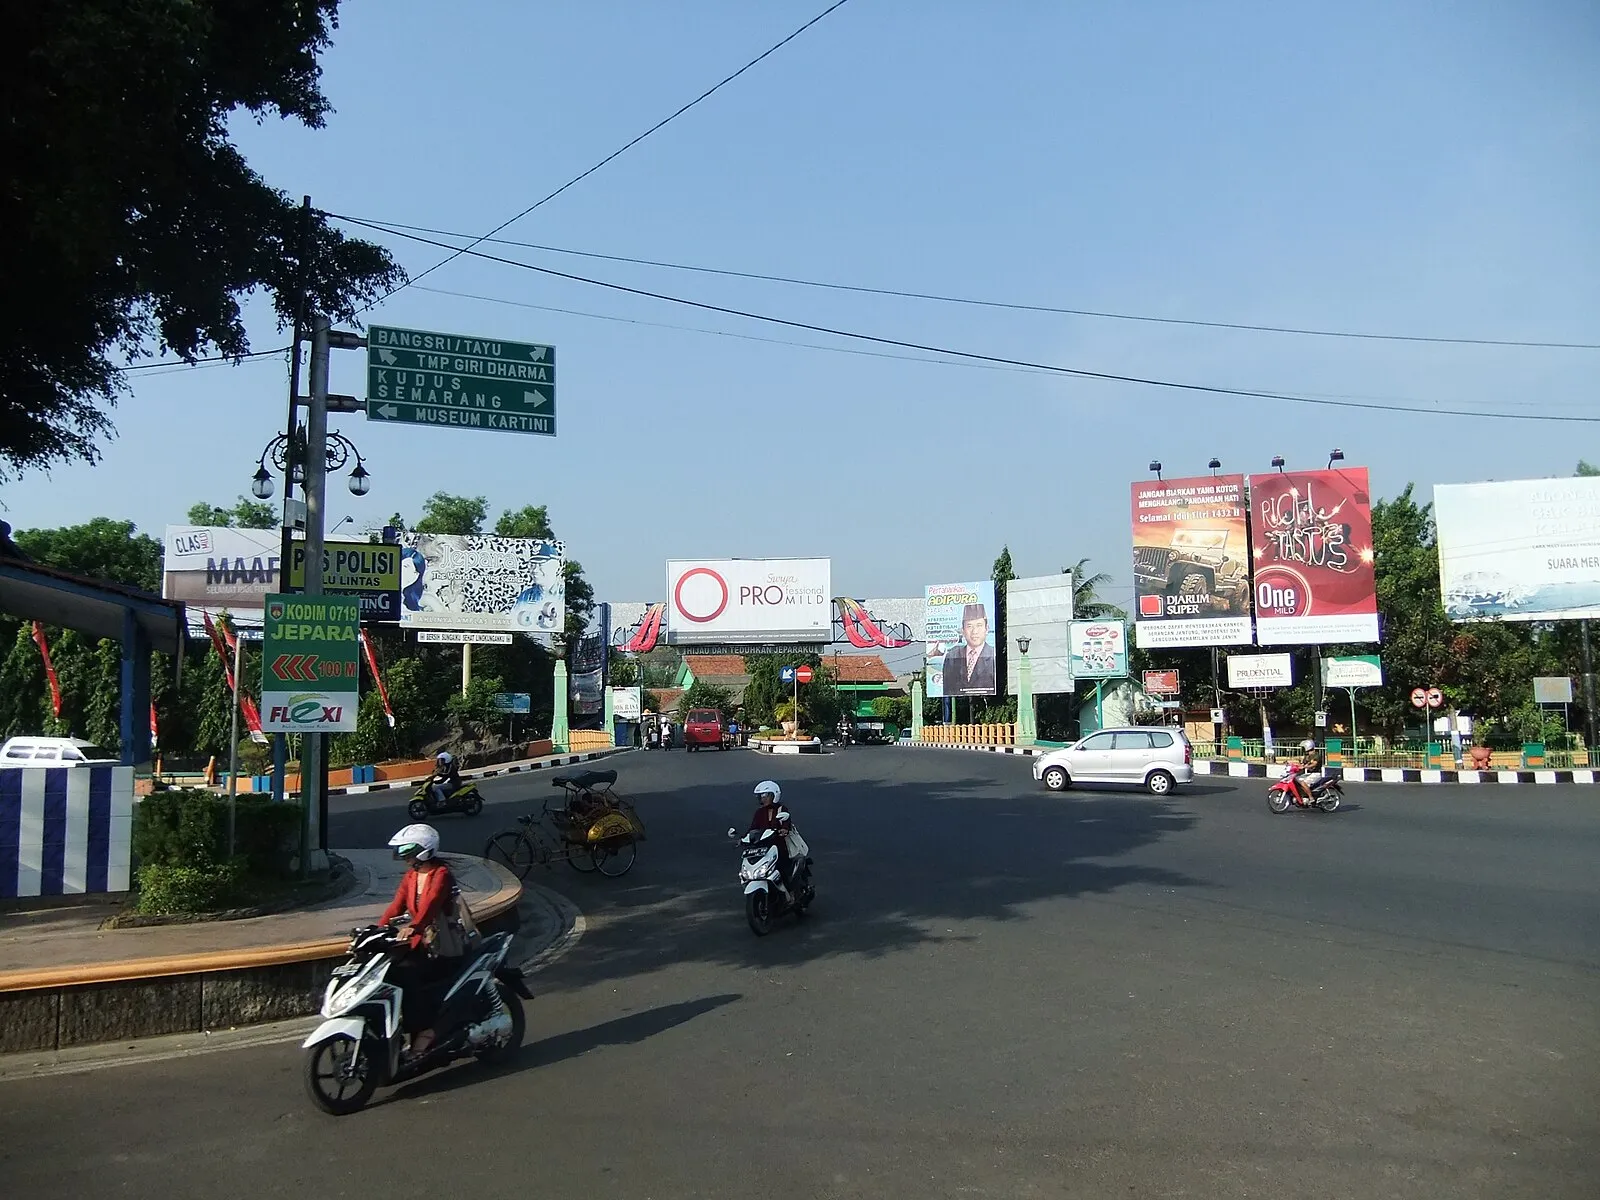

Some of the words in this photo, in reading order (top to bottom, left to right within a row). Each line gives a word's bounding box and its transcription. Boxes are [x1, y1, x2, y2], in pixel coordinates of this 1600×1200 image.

[454, 358, 484, 374] GIRI
[487, 361, 547, 380] DHARMA
[378, 370, 461, 390] KUDUS
[378, 385, 502, 408] SEMARANG
[416, 408, 481, 426] MUSEUM
[488, 414, 548, 432] KARTINI
[1138, 490, 1164, 499] JANGAN
[1196, 486, 1215, 495] YANG
[1216, 484, 1238, 493] KOTOR
[1184, 496, 1223, 505] PANDANGAN
[1224, 494, 1239, 502] HATI
[1139, 513, 1170, 522] Selamat
[1212, 509, 1231, 518] 1432
[1233, 508, 1240, 516] H
[294, 549, 330, 572] PS
[336, 550, 394, 575] POLISI
[440, 545, 518, 570] Jepara
[1547, 558, 1578, 570] SUARA
[207, 557, 280, 584] MAAF
[432, 571, 447, 580] The
[448, 572, 471, 581] World
[340, 577, 380, 586] LINTAS
[767, 573, 797, 587] Surya
[785, 595, 824, 604] MILD
[927, 593, 977, 606] ADIPURA
[1167, 594, 1210, 606] DJARUM
[1258, 582, 1295, 608] One
[286, 604, 326, 621] KODIM
[329, 606, 357, 621] 0719
[1167, 604, 1200, 615] SUPER
[270, 624, 356, 641] JEPARA
[687, 646, 710, 655] HIJAU
[712, 646, 727, 655] DAN
[730, 645, 771, 654] TEDUHKAN
[319, 661, 341, 677] 100
[345, 661, 356, 677] M
[1236, 668, 1284, 677] PRUDENTIAL
